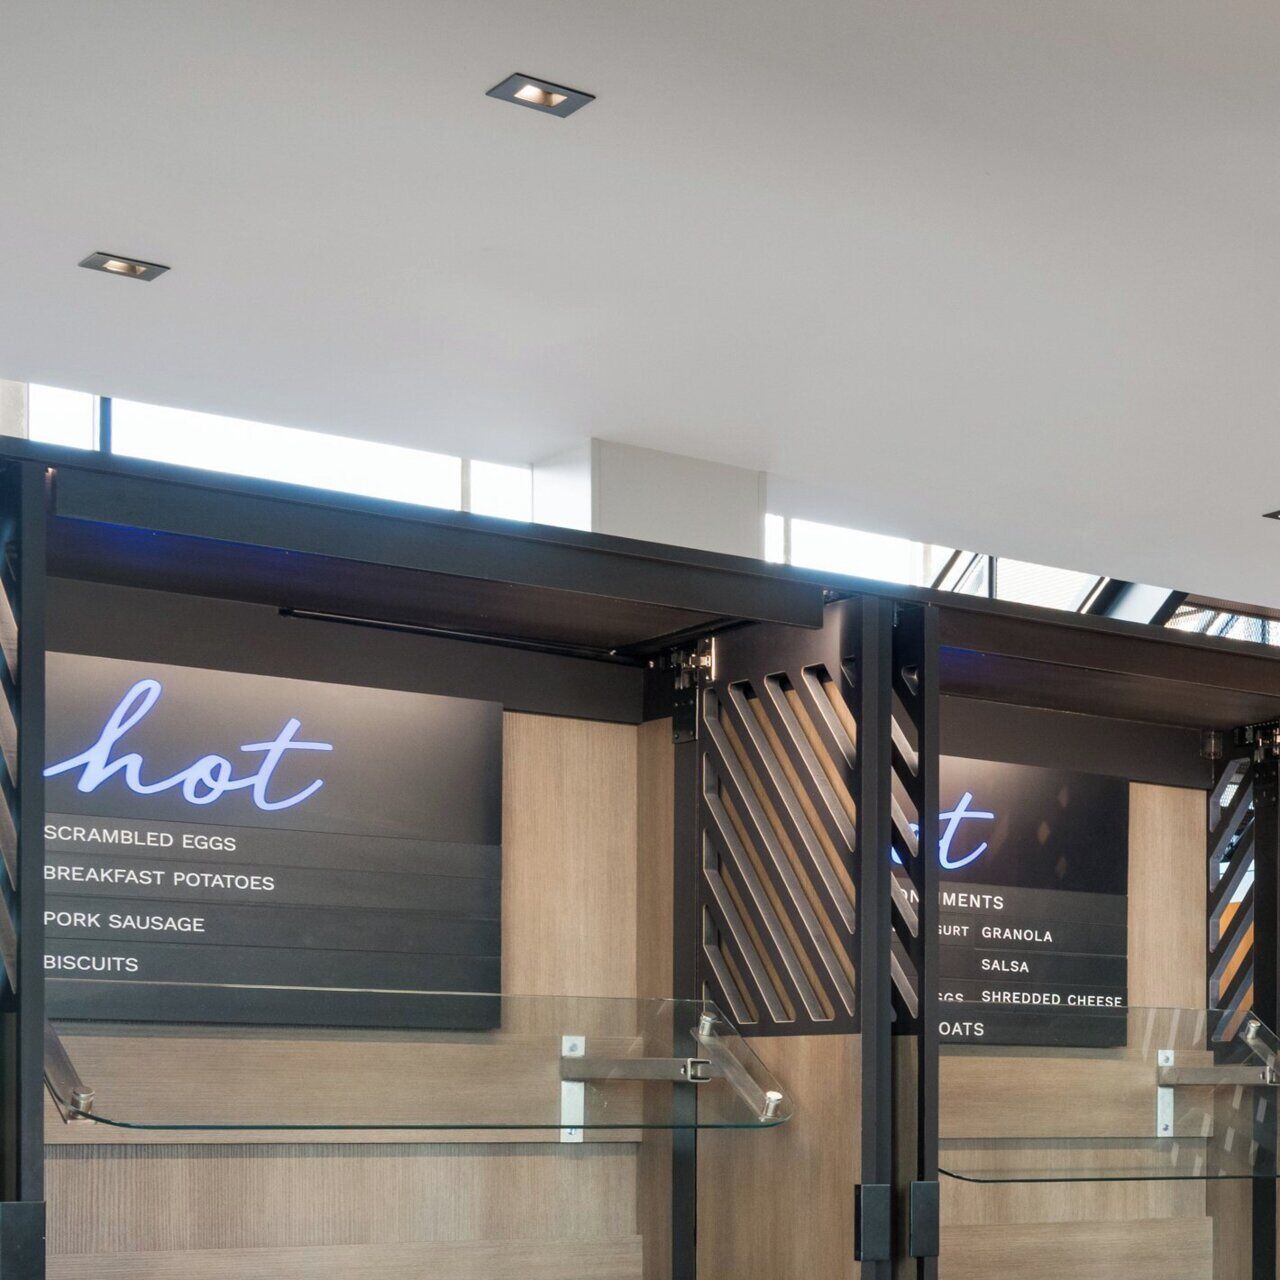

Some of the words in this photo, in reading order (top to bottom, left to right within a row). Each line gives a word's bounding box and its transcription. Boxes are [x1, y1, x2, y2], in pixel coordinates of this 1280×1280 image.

[42, 678, 334, 811] hot
[43, 824, 174, 848] SCRAMBLED
[182, 834, 237, 851] EGGS
[43, 865, 165, 885] BREAKFAST
[173, 871, 275, 891] POTATOES
[43, 911, 101, 928] PORK
[108, 914, 205, 932] SAUSAGE
[981, 926, 1053, 943] GRANOLA
[43, 954, 139, 972] BISCUITS
[981, 958, 1030, 973] SALSA
[981, 990, 1061, 1005] SHREDDED
[1067, 994, 1123, 1008] CHEESE
[938, 1021, 985, 1036] OATS
